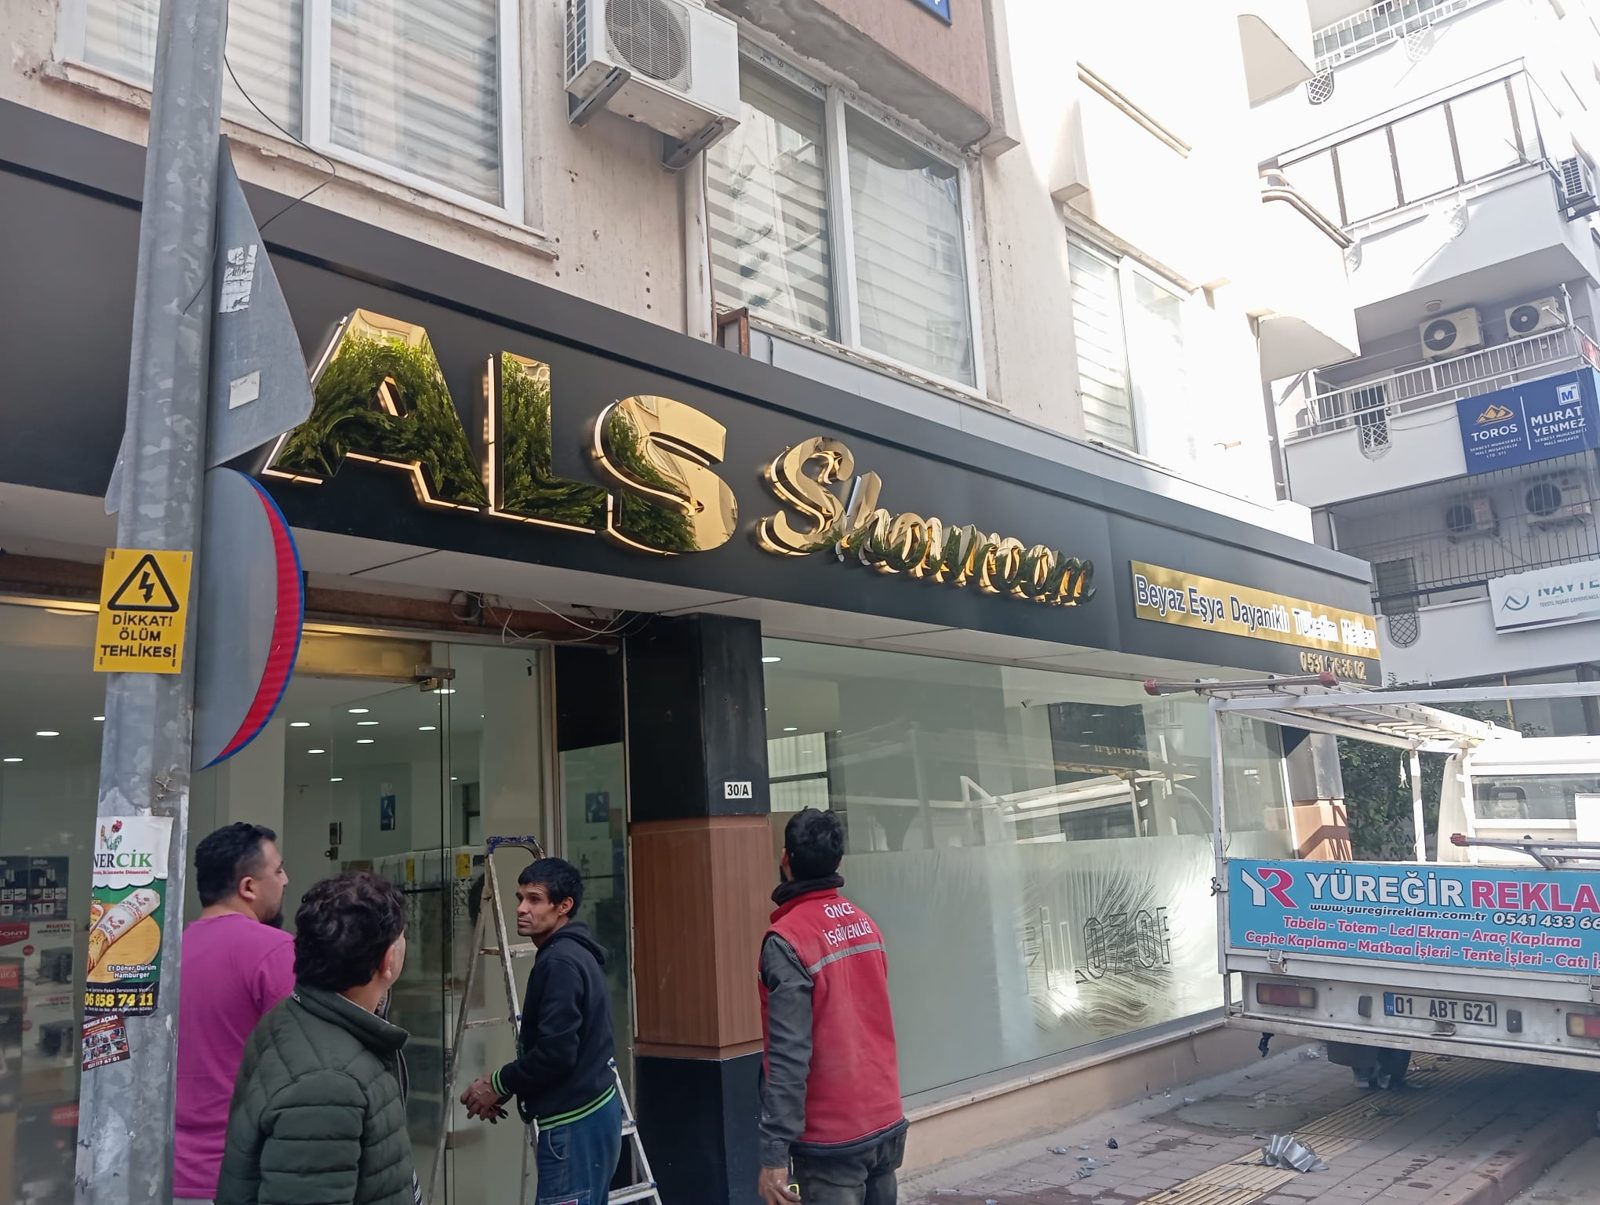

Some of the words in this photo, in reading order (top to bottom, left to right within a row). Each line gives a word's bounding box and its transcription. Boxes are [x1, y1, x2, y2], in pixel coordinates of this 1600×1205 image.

[1530, 405, 1583, 427] MURAT
[262, 307, 740, 557] ALS
[1471, 423, 1518, 442] TOROS
[1533, 418, 1587, 437] YENMEZ
[754, 436, 1096, 607] Showroom
[1134, 574, 1186, 617] Beyaz
[1188, 587, 1224, 624] Eşya
[112, 612, 173, 627] DİKKAT!
[119, 627, 161, 642] ÖLÜM
[100, 643, 177, 658] TEHLİKESİ
[727, 784, 749, 796] 30/A
[1305, 868, 1465, 908] YÜREĞİR
[1471, 879, 1600, 914] REKLA
[824, 902, 855, 918] ÖNCE
[1310, 903, 1487, 922] www.yuregirreklam.com.tr
[1493, 911, 1537, 927] 0541
[1540, 913, 1575, 929] 433
[1283, 915, 1326, 931] Tabela
[1338, 920, 1378, 935] Totem
[1389, 923, 1414, 937] Led
[1417, 925, 1460, 941] Ekran
[1471, 929, 1507, 945] Araç
[1510, 931, 1582, 948] Kaplama
[1245, 930, 1285, 946] Cephe
[1288, 933, 1347, 952] Kaplama
[1358, 939, 1412, 956] Matbaa
[1415, 941, 1450, 959] İşleri
[1463, 947, 1501, 962] Tente
[1505, 947, 1543, 966] İşleri
[95, 993, 115, 1007] 858
[118, 993, 136, 1007] 74
[139, 992, 153, 1006] 11
[1395, 996, 1413, 1015] 01
[1429, 1000, 1458, 1019] ABT
[1463, 1003, 1492, 1023] 621
